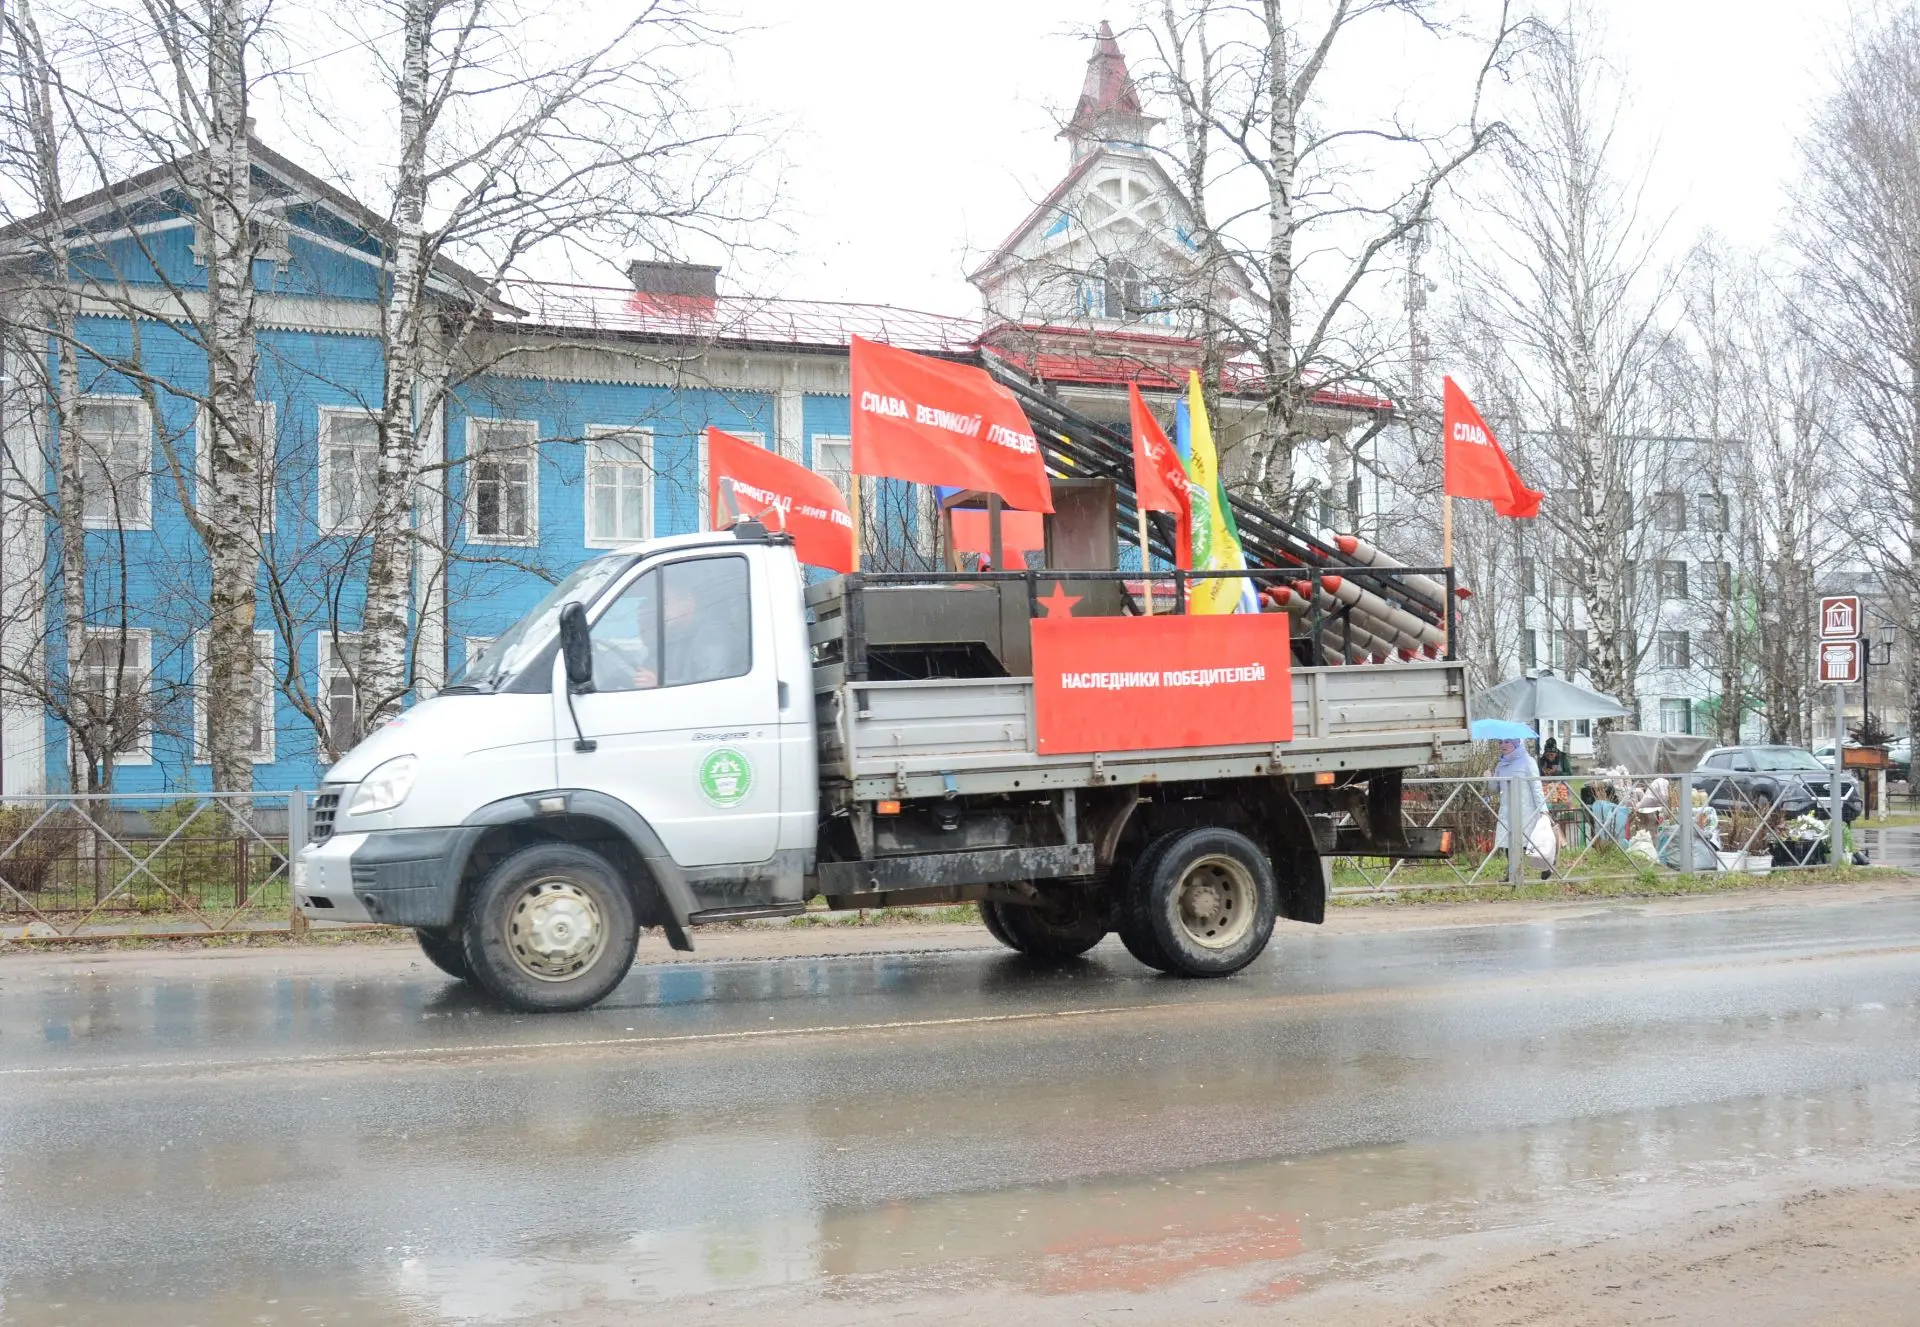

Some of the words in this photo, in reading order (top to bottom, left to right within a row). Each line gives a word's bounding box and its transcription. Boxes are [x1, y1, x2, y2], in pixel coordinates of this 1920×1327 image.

[861, 391, 909, 418] СЛАВА
[916, 404, 982, 437] ВЕЛИКОЙ
[1453, 422, 1487, 446] СЛАВА
[1061, 672, 1160, 691] НАСЛЕДНИКИ
[1163, 662, 1265, 688] ПОБЕДИТЕЛЕЙ!
